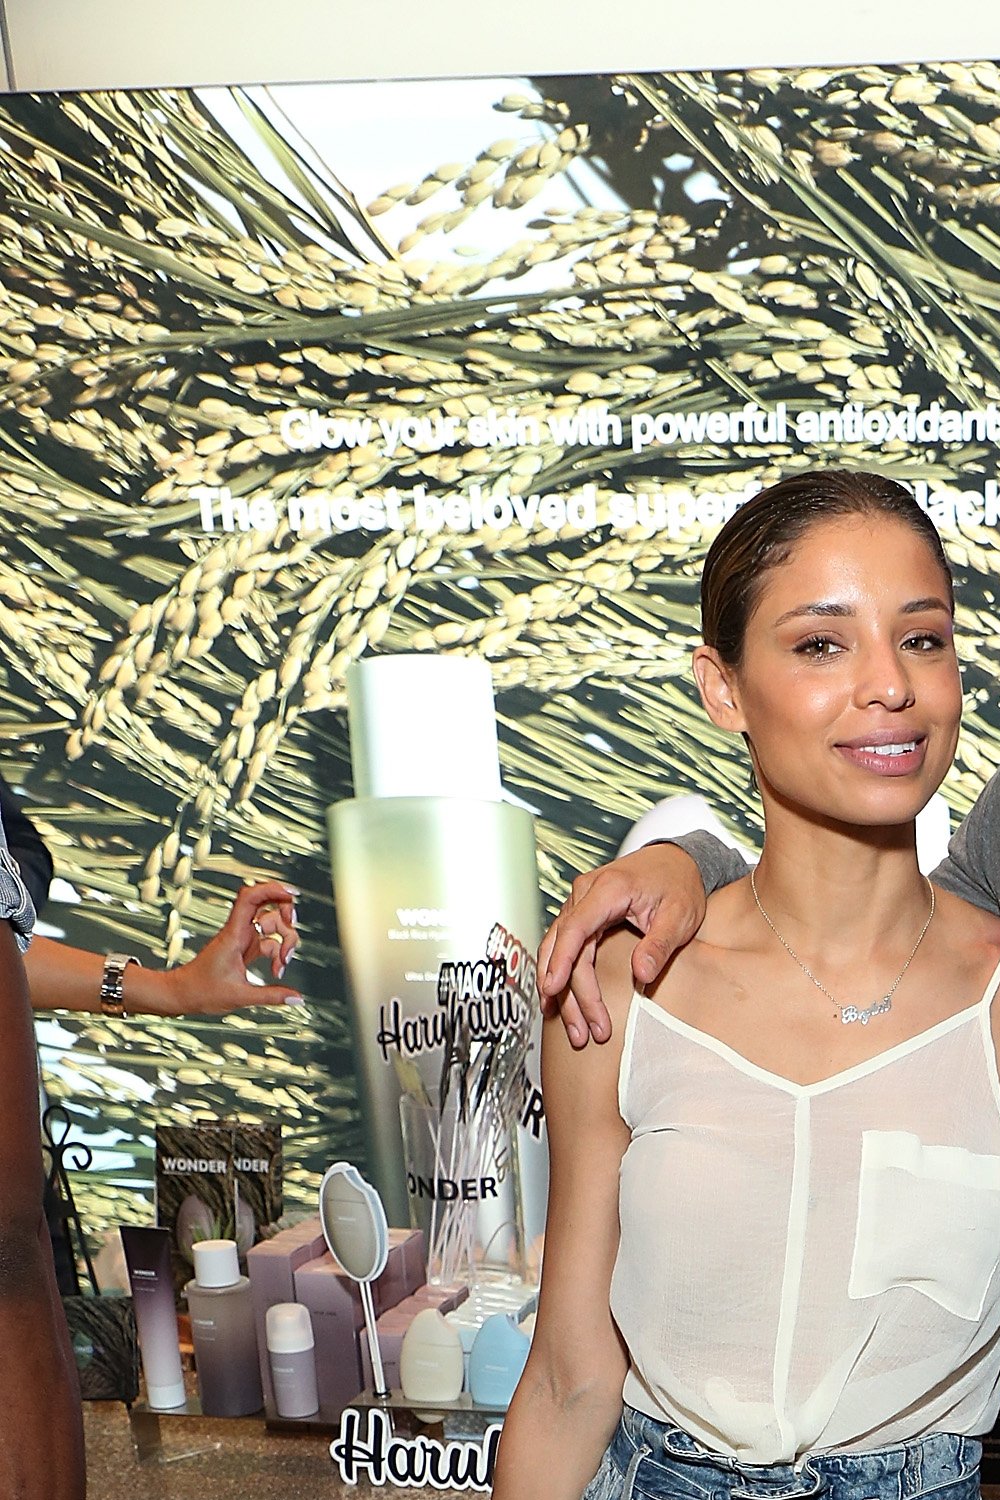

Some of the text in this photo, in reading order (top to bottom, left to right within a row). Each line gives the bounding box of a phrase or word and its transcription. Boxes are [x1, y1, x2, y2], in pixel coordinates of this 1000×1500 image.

[280, 409, 371, 449] Glow
[379, 416, 459, 457] your
[467, 408, 540, 447] skin
[550, 405, 622, 446] with
[632, 402, 786, 453] powerful
[188, 487, 278, 532] The
[288, 486, 404, 532] most
[413, 483, 600, 532] beloved
[161, 1156, 228, 1174] WONDER
